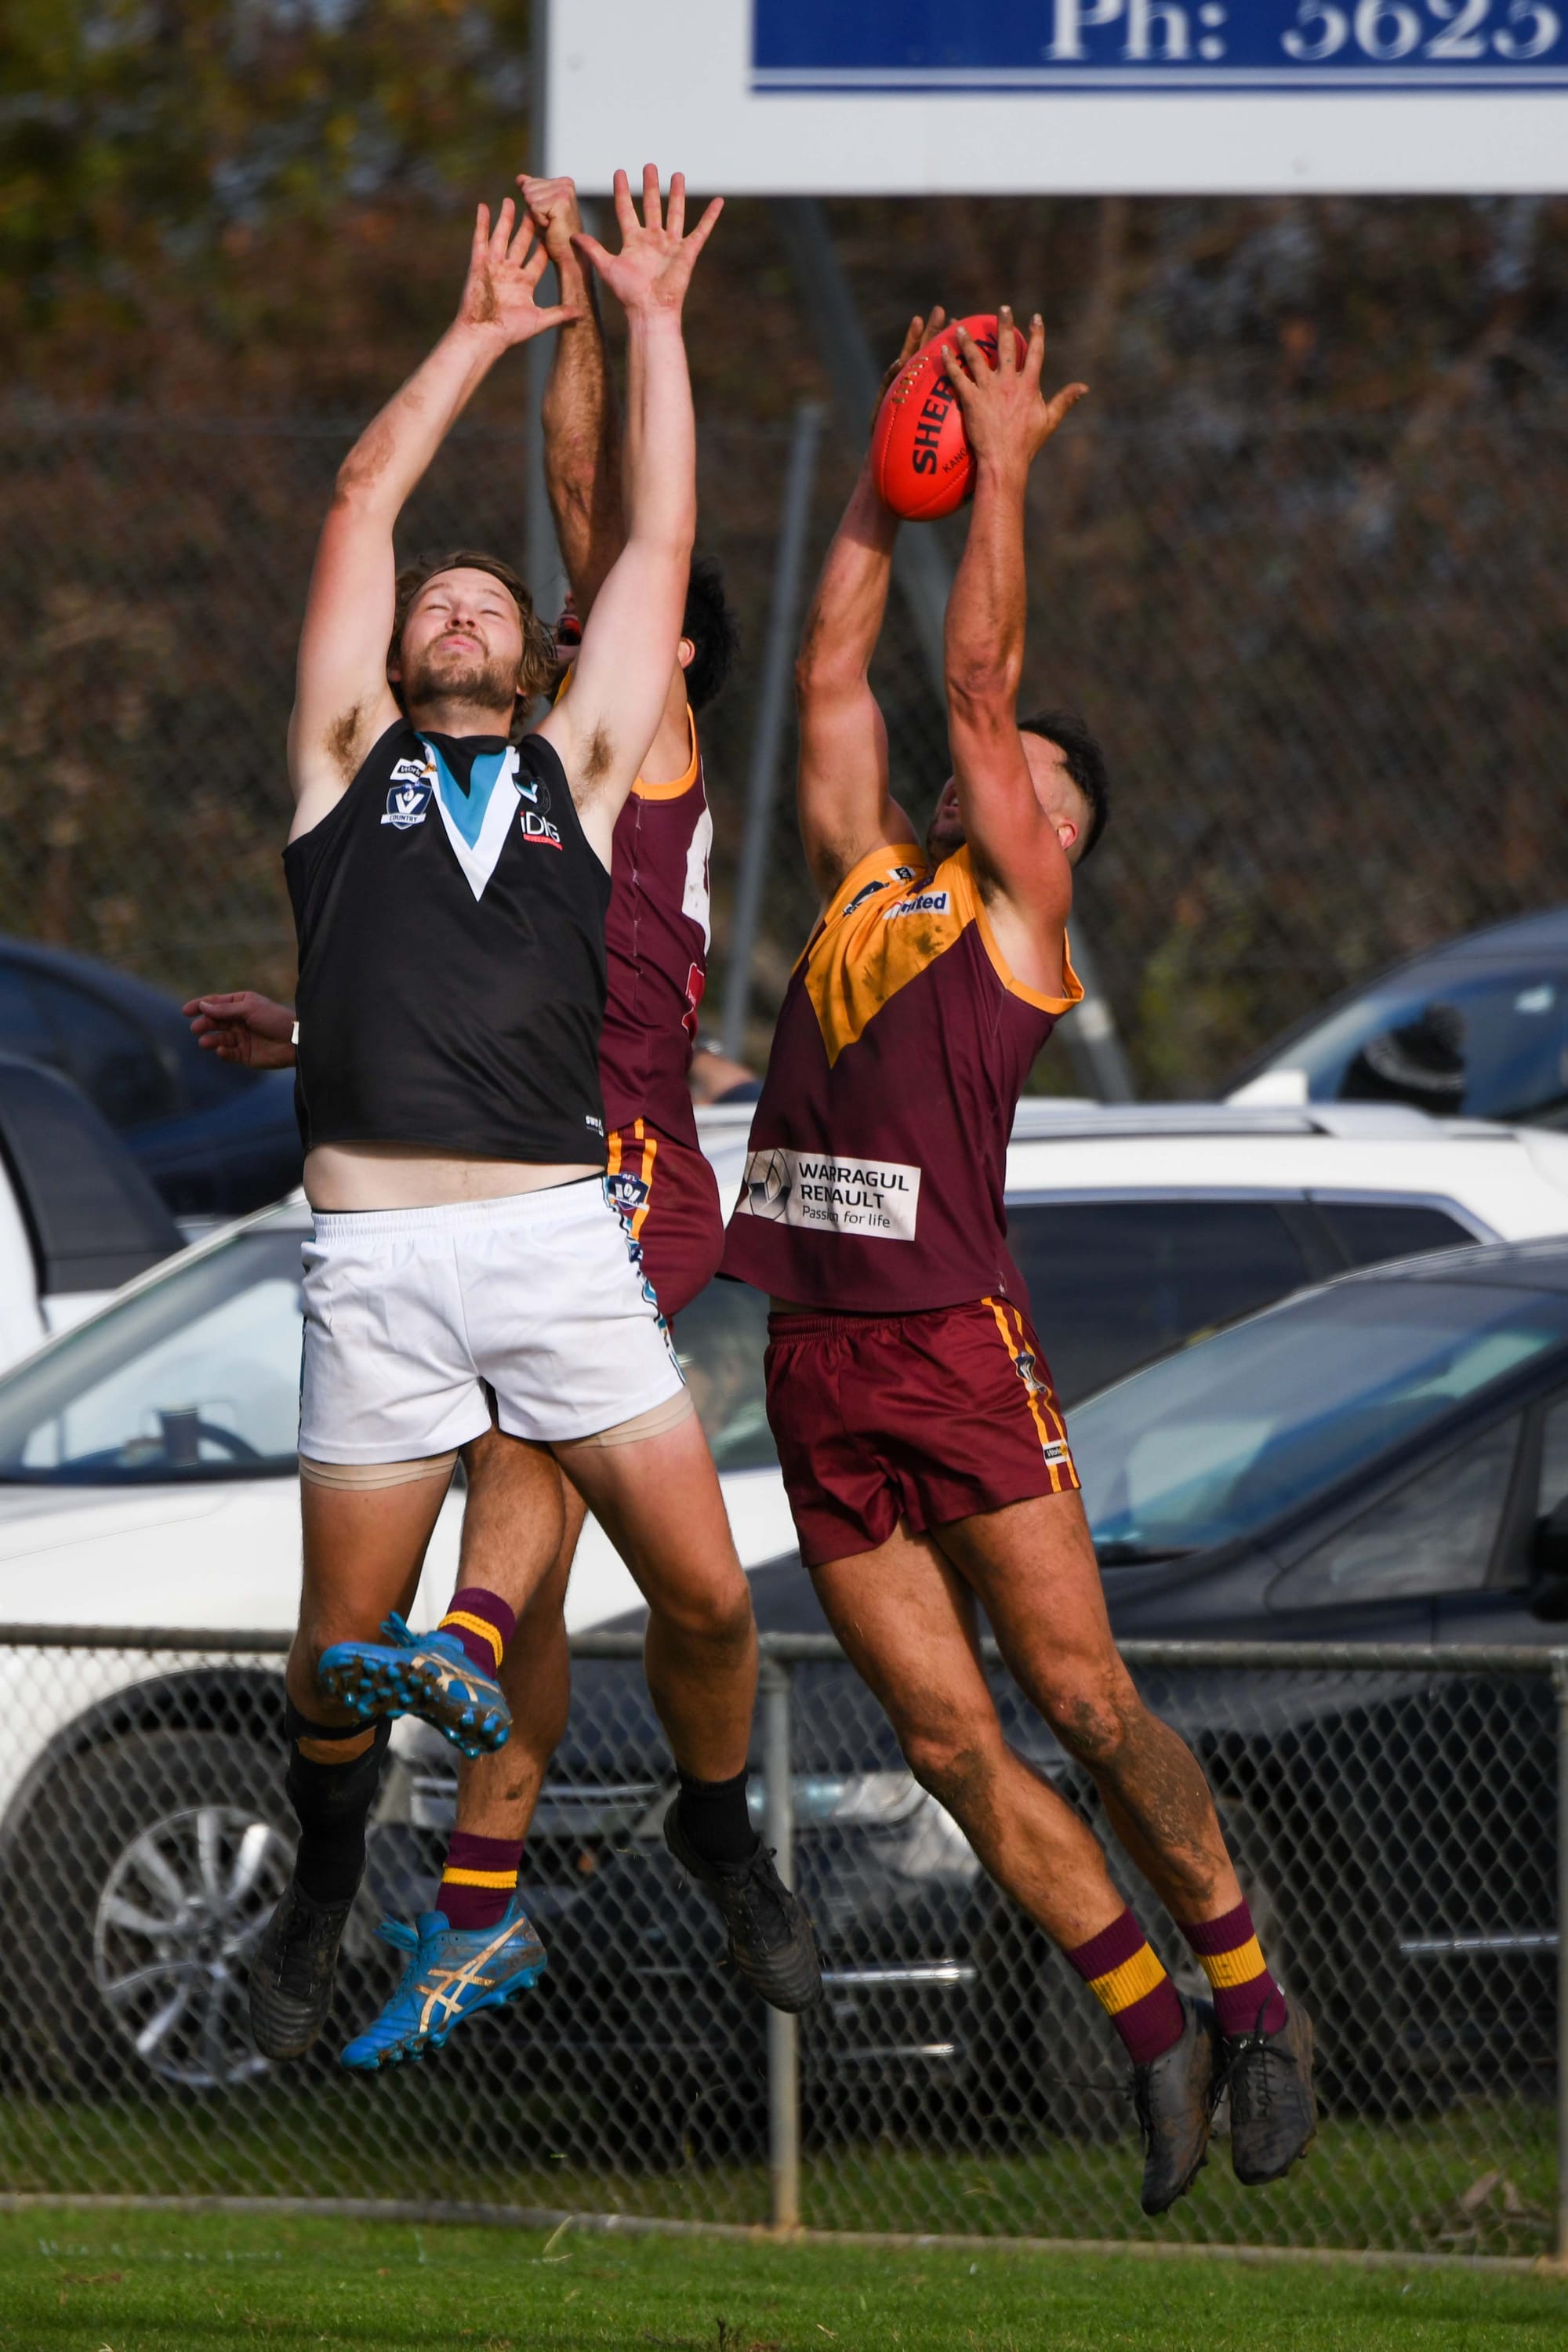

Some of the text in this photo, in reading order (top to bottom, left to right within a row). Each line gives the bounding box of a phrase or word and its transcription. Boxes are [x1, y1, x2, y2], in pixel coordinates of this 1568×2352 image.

[1042, 0, 1229, 60] Ph:
[798, 1162, 909, 1192] WARRAGUL
[800, 1184, 885, 1209] RENAULT
[844, 1210, 866, 1224] for
[868, 1213, 891, 1229] life
